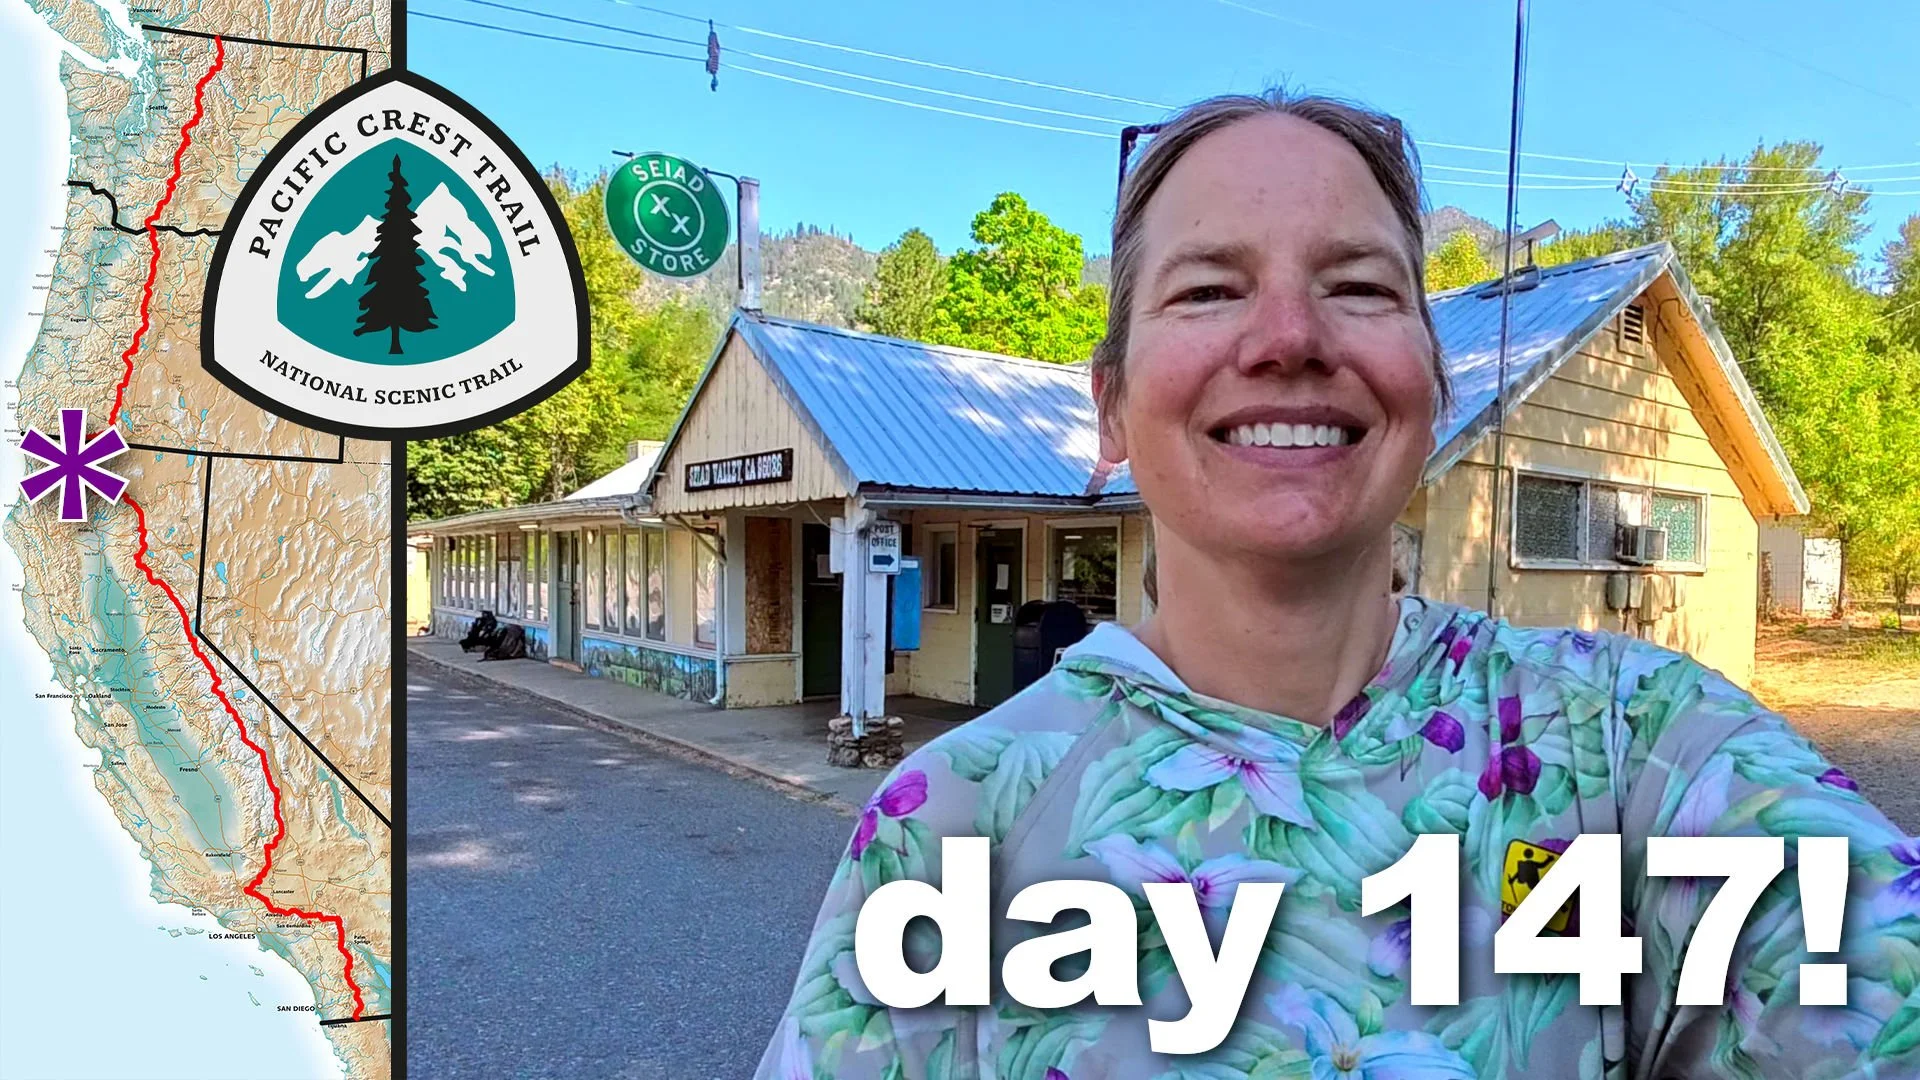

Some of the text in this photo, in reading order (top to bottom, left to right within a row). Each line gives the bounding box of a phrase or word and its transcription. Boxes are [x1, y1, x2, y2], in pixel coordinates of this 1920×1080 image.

[632, 160, 704, 192] SEIAD
[630, 238, 710, 272] STORE
[874, 525, 894, 534] POST
[871, 537, 897, 548] OFFICE
